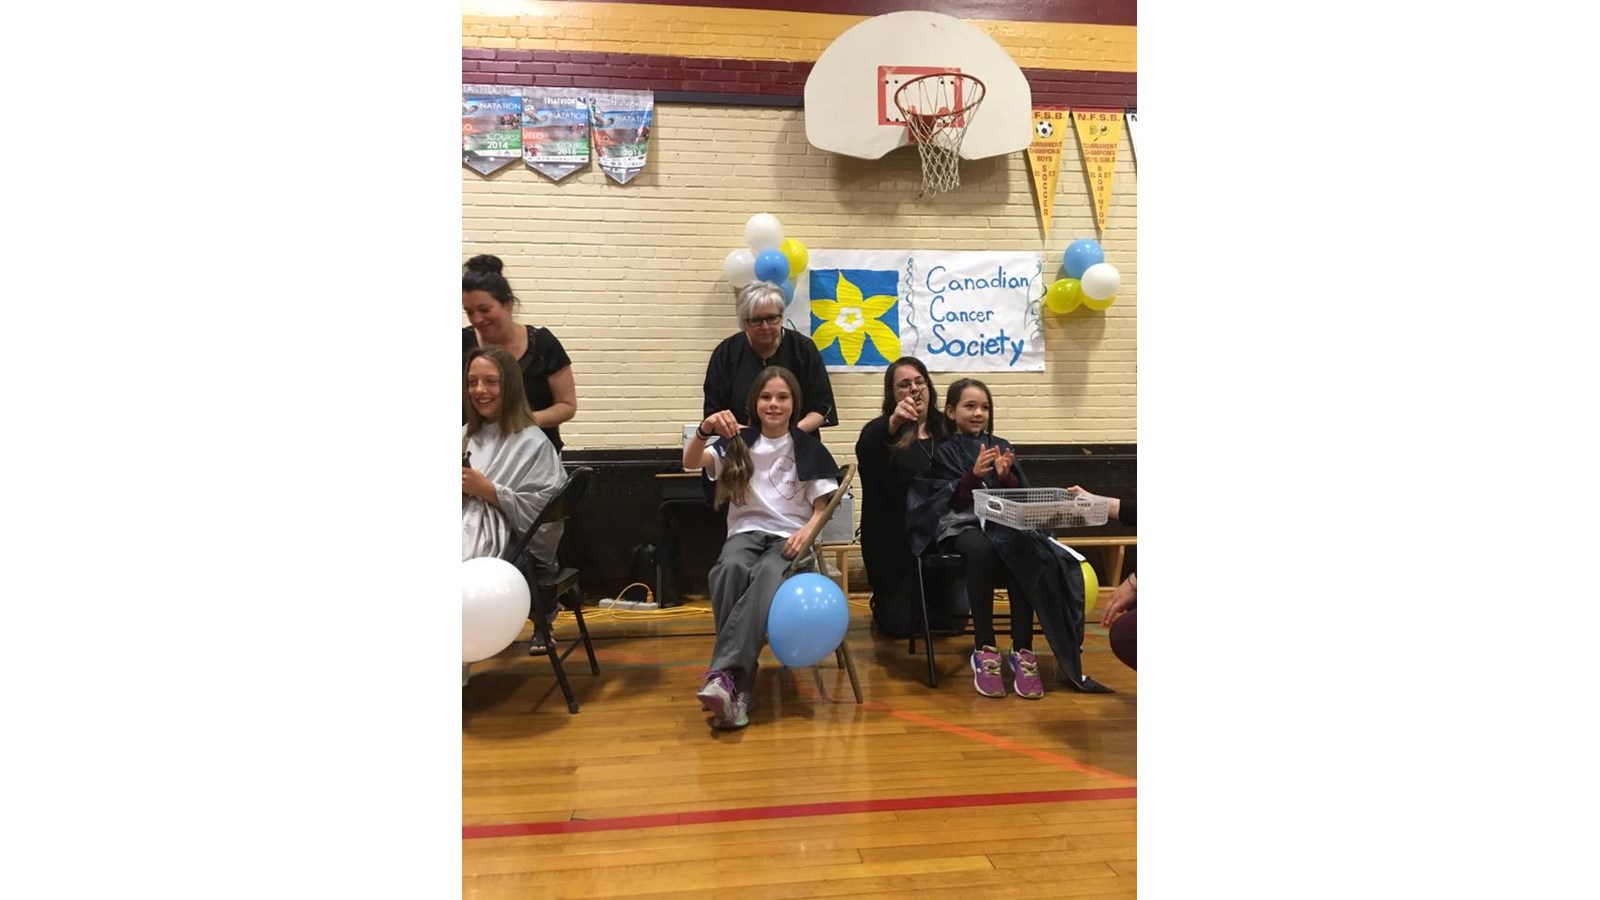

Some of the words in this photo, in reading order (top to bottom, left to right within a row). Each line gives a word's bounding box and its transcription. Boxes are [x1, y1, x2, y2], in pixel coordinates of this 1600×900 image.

[550, 112, 588, 120] NATATION
[486, 141, 508, 149] 2014
[1041, 164, 1049, 216] SOCCER
[1097, 166, 1105, 224] BADMINTON
[926, 265, 1029, 294] Canadian
[930, 295, 994, 323] Cancer
[927, 324, 1025, 366] Society
